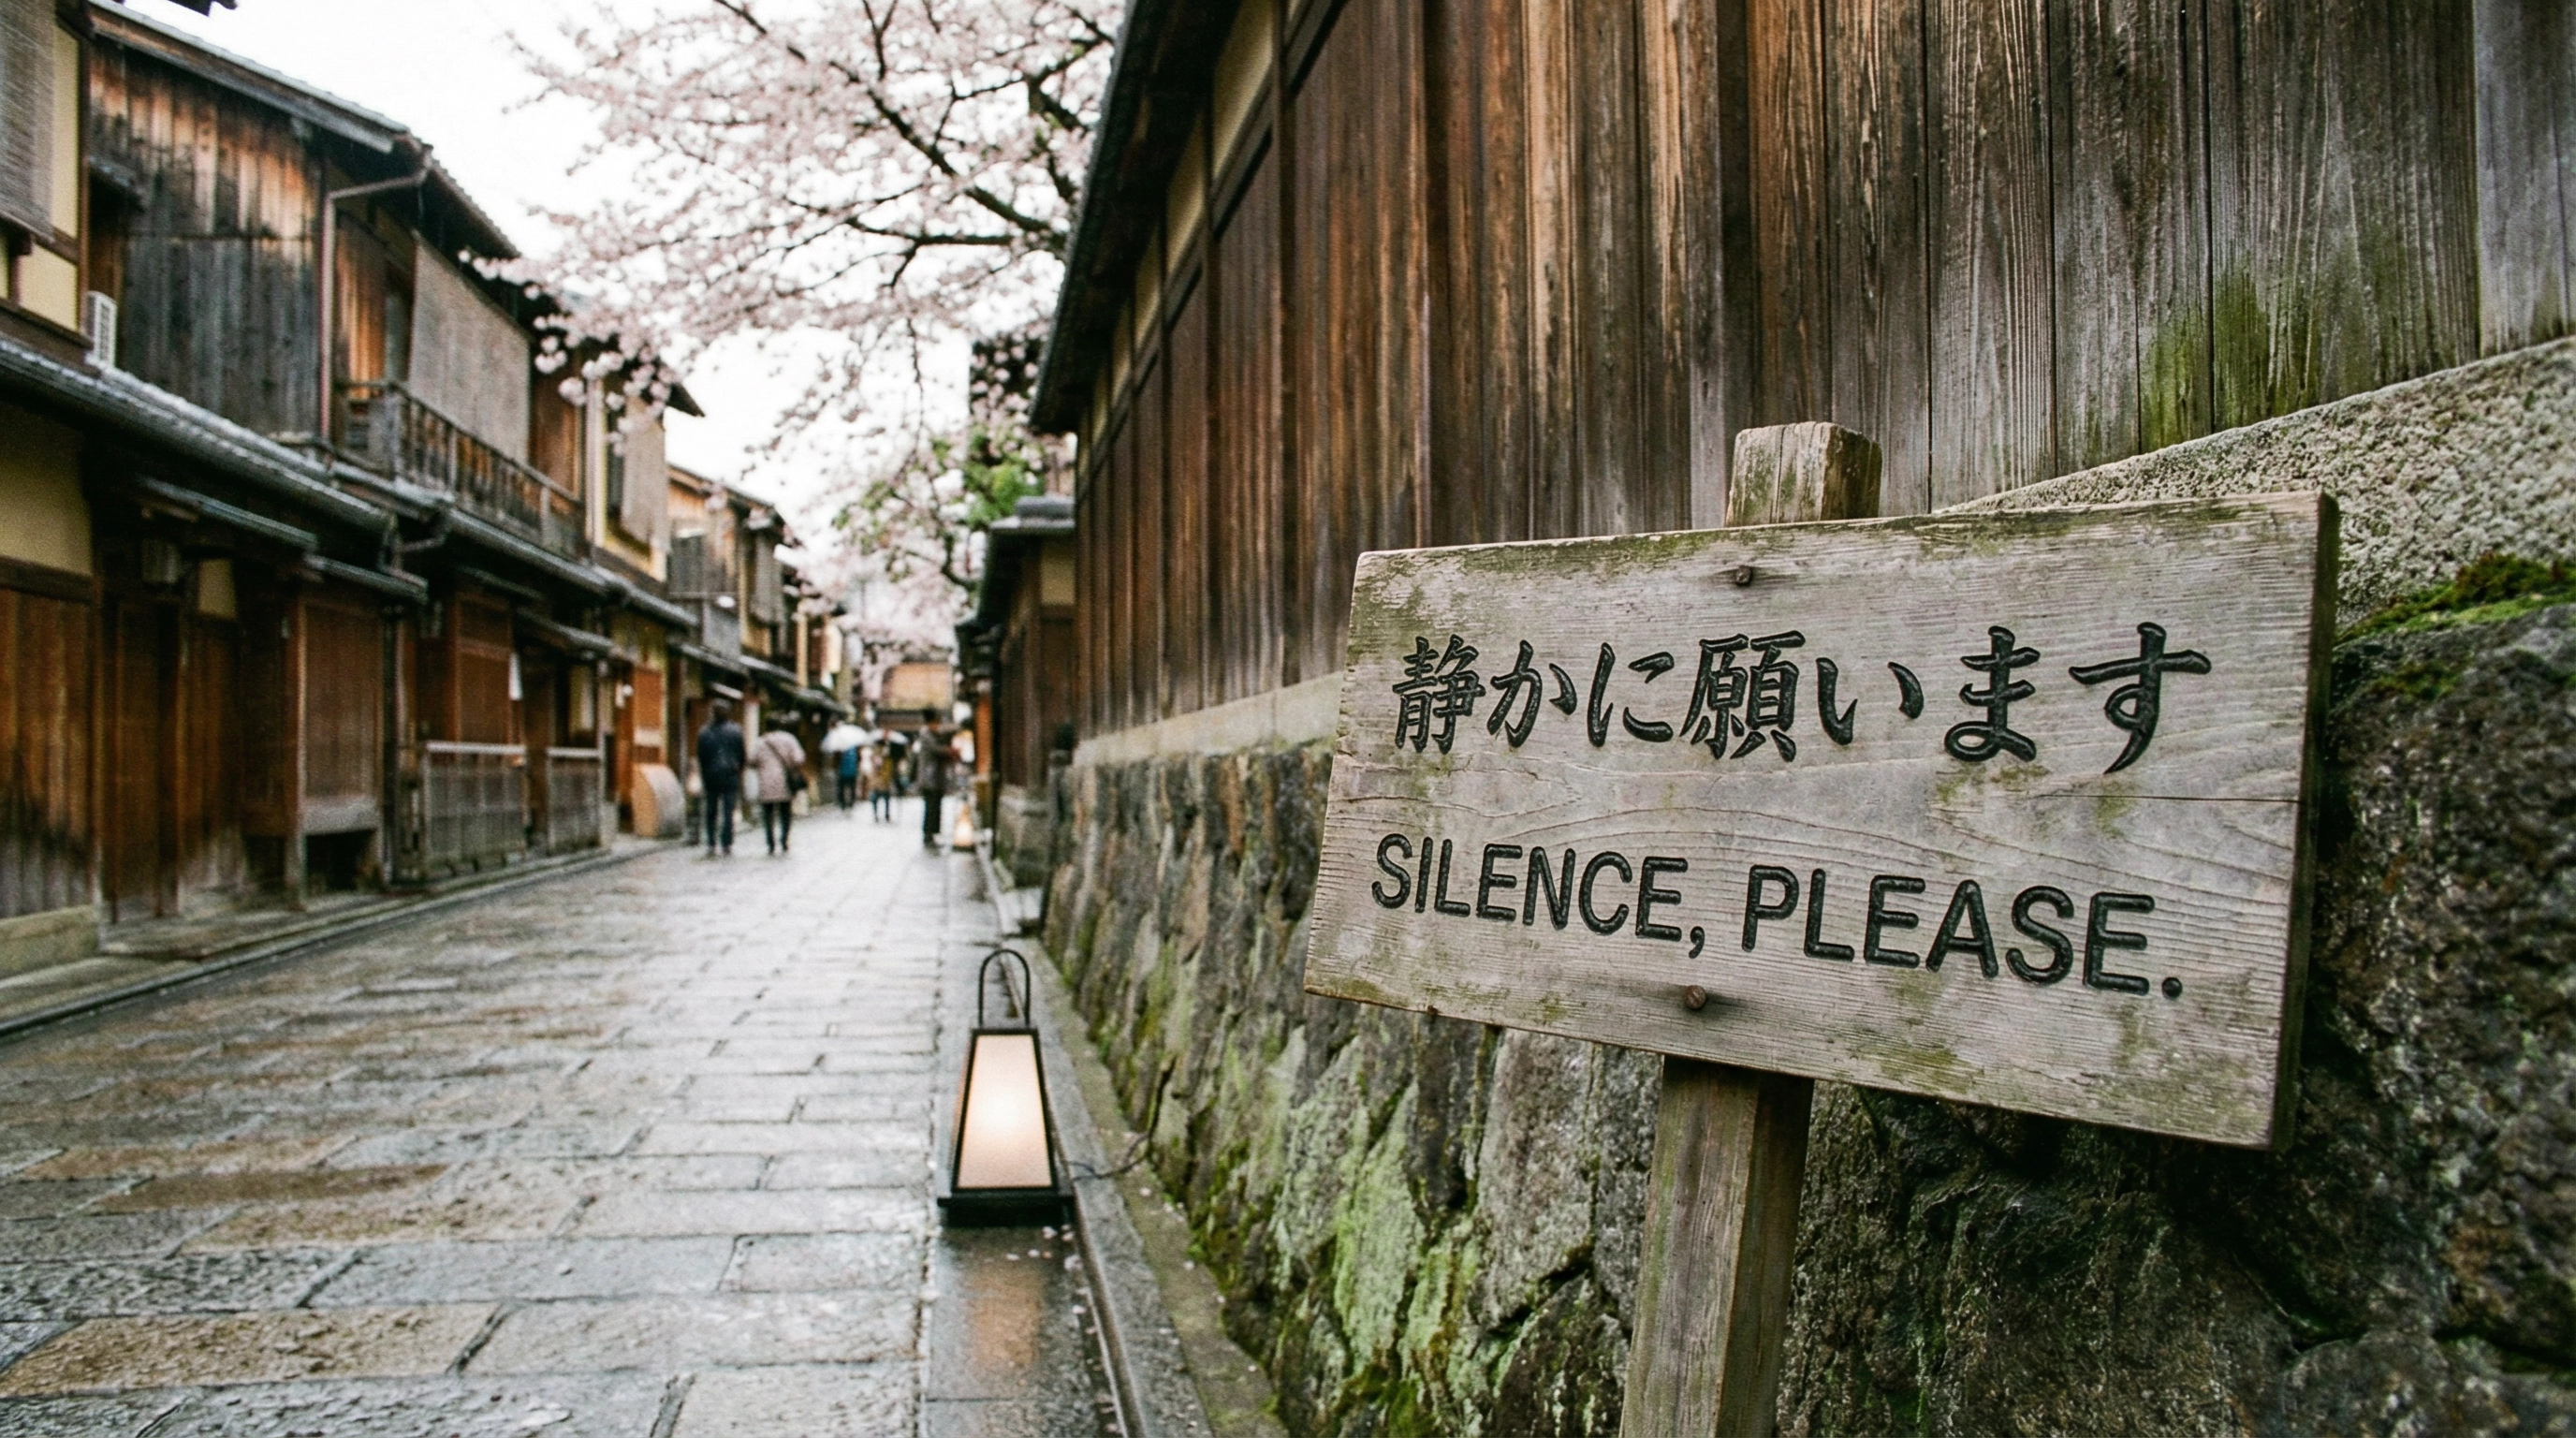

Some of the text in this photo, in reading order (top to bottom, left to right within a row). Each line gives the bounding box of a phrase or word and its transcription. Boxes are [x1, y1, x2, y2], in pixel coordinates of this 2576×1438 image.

[1391, 622, 2212, 774] 静かに願います
[1371, 833, 2184, 1000] SILENCE, PLEASE.
